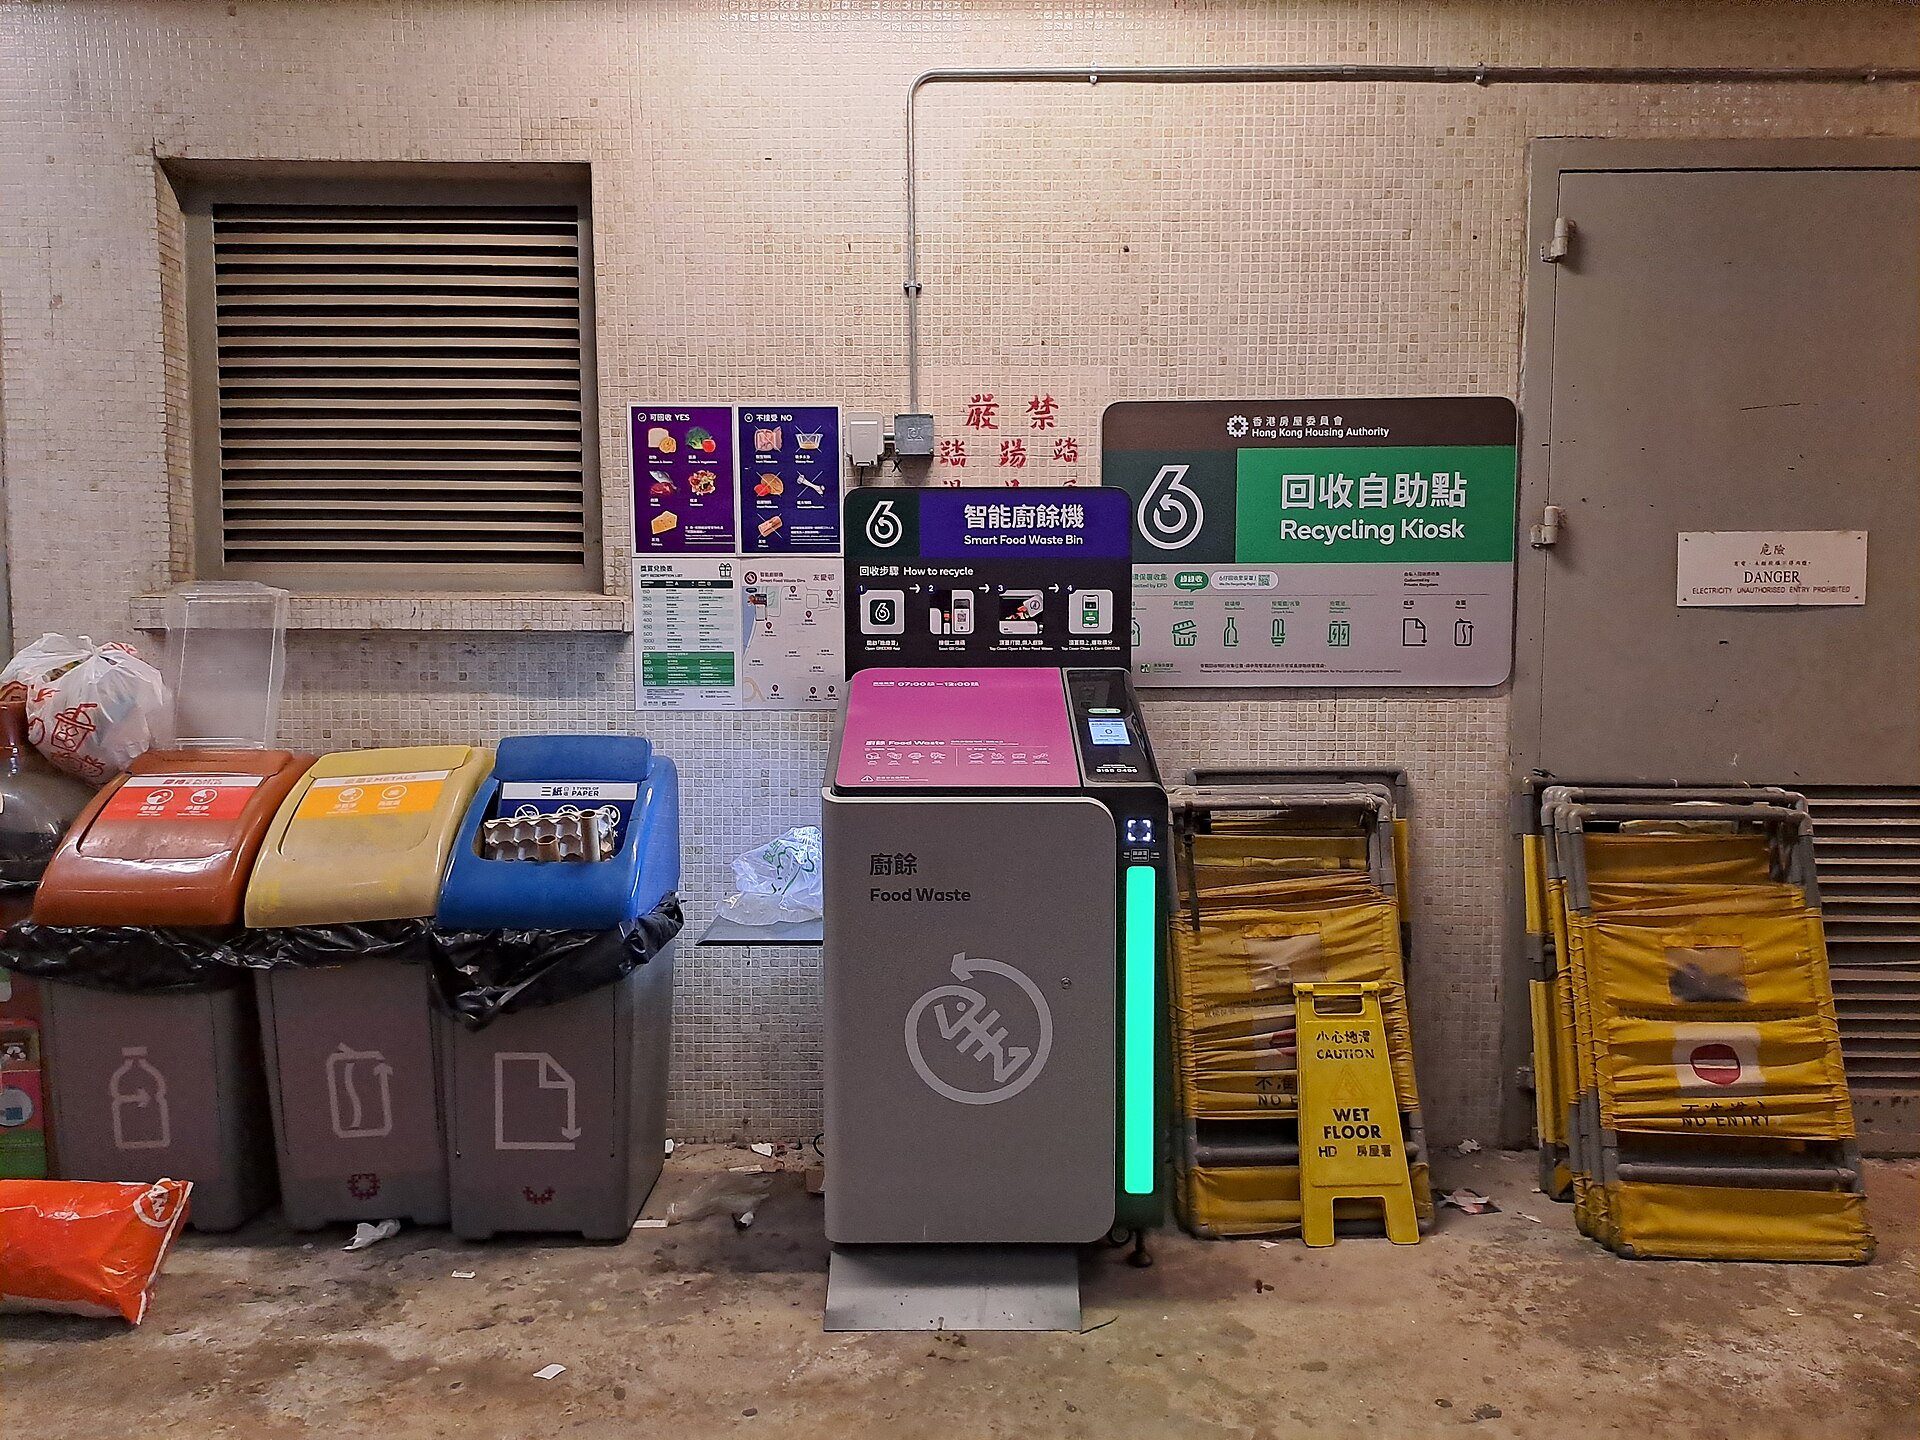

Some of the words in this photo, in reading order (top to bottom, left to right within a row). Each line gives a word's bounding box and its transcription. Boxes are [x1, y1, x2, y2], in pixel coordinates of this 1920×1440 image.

[1252, 415, 1343, 427] 香港房屋委員會
[1252, 427, 1277, 439] Hong
[1278, 427, 1303, 439] Kong
[1305, 426, 1344, 439] Housing
[1346, 425, 1390, 438] Authority
[1281, 471, 1467, 510] 回收自助點
[964, 504, 1084, 529] 智能廚餘機
[1280, 519, 1396, 546] Recycling
[1400, 517, 1465, 540] Kiosk
[964, 535, 998, 545] Smart
[1000, 535, 1027, 545] Food
[1028, 535, 1064, 545] Waste
[1065, 535, 1084, 545] Bin
[1760, 543, 1786, 556] 危險
[903, 567, 926, 576] How
[927, 567, 938, 576] to
[940, 567, 974, 578] recycle
[1744, 570, 1800, 584] DANGER
[1692, 587, 1732, 595] ELECTRICITY
[1812, 586, 1850, 594] PROHIBITED
[870, 852, 918, 876] 廚餘
[870, 888, 912, 902] Food
[916, 888, 971, 902] Waste
[1316, 1030, 1370, 1044] 小心地滑
[1316, 1049, 1375, 1060] CAUTION
[1258, 1094, 1281, 1106] NO
[1332, 1108, 1370, 1122] WET
[1716, 1116, 1769, 1126] ENTRY
[1323, 1125, 1382, 1139] FLOOR
[1318, 1146, 1337, 1157] HD
